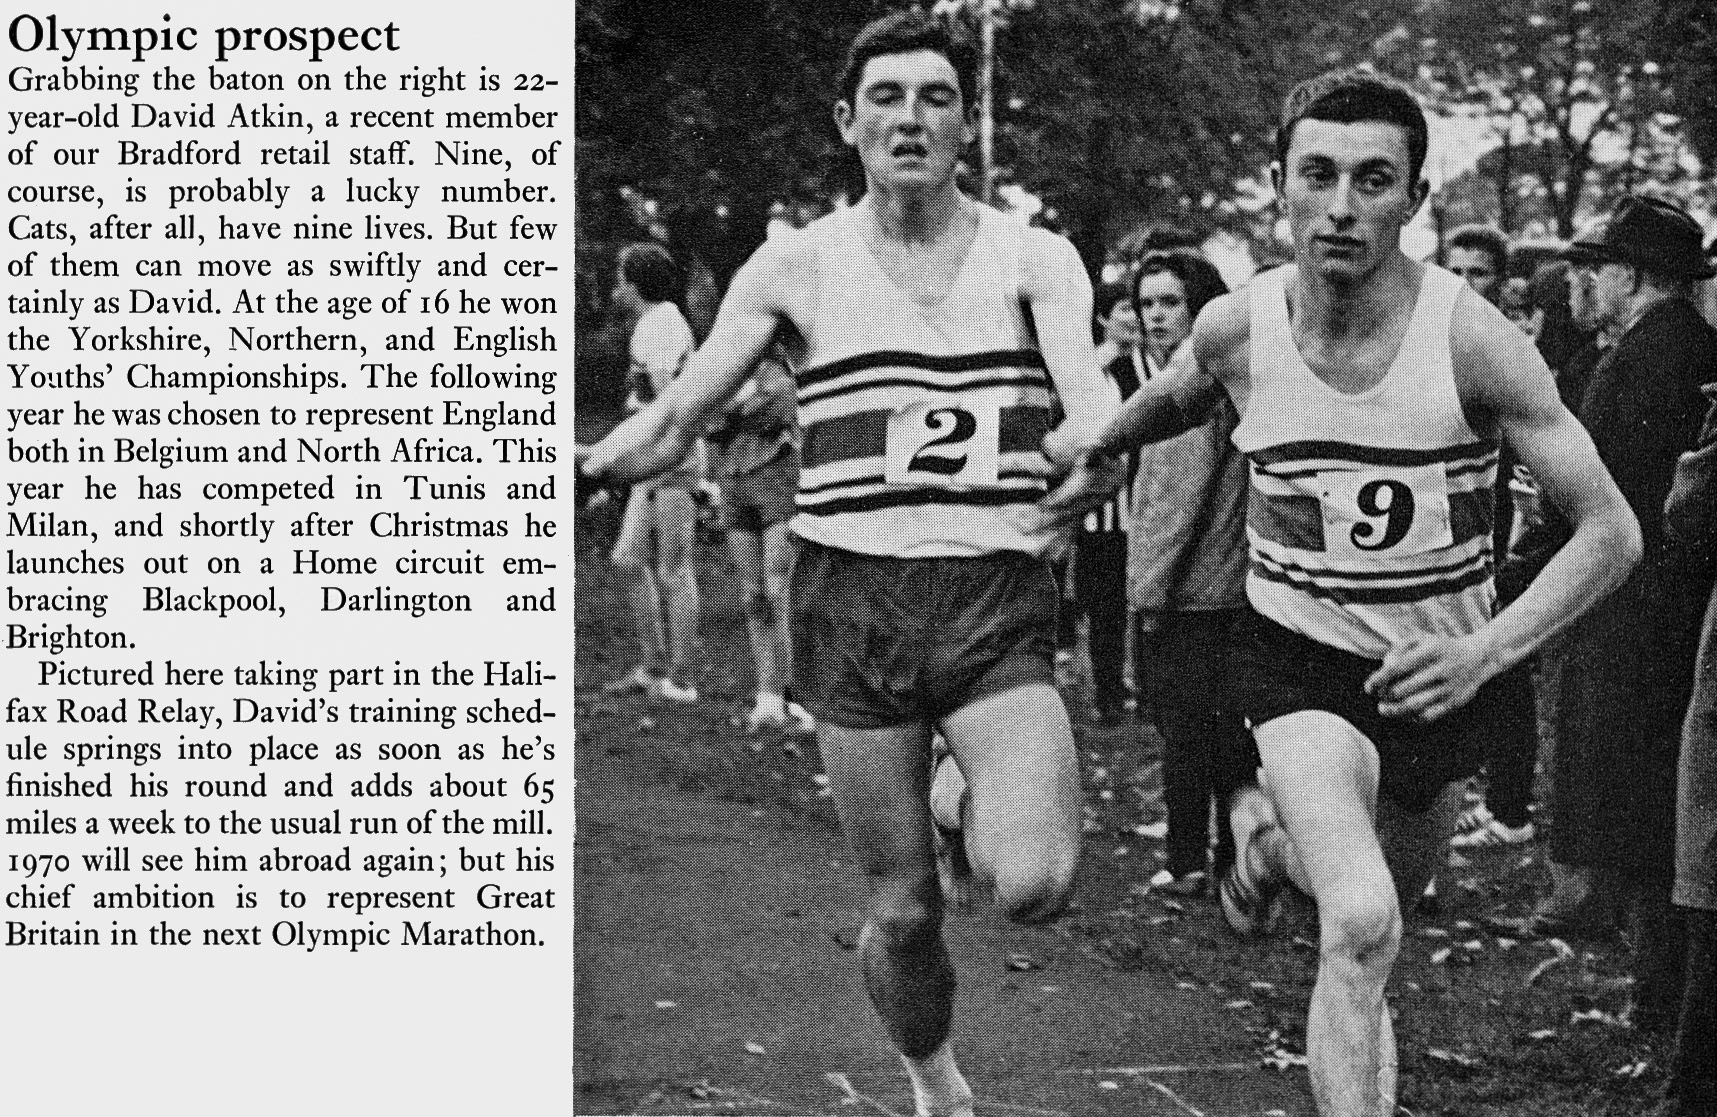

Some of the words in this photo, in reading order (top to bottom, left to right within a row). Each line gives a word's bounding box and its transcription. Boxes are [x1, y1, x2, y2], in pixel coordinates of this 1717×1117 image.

[8, 13, 198, 63] Olympic
[214, 21, 401, 63] prospect
[8, 64, 141, 98] Grabbing
[152, 65, 196, 91] the
[207, 64, 285, 91] baton
[297, 73, 332, 91] on
[343, 64, 387, 91] the
[399, 65, 467, 98] right
[478, 65, 501, 92] is
[513, 73, 559, 92] 22-
[7, 102, 120, 135] year-old
[130, 102, 216, 129] David
[226, 102, 314, 135] Atkin,
[325, 110, 340, 128] a
[349, 108, 435, 128] recent
[445, 102, 559, 129] member
[7, 139, 39, 166] of
[53, 148, 100, 166] our
[117, 139, 242, 166] Bradford
[260, 139, 331, 166] retail
[349, 139, 415, 166] staff.
[434, 140, 512, 173] Nine,
[531, 139, 562, 166] of
[7, 184, 104, 210] course,
[125, 176, 147, 203] is
[168, 176, 291, 210] probably
[311, 184, 326, 203] a
[345, 176, 421, 210] lucky
[440, 177, 556, 204] number.
[8, 214, 77, 247] Cats,
[89, 213, 153, 240] after
[164, 214, 205, 247] all,
[218, 214, 281, 240] have
[293, 213, 353, 240] nine
[364, 214, 433, 241] lives.
[446, 214, 498, 241] But
[509, 214, 558, 241] few
[7, 250, 39, 277] of
[49, 251, 120, 277] them
[135, 259, 183, 278] can
[197, 259, 272, 277] move
[287, 259, 314, 277] as
[329, 250, 422, 284] swiftly
[437, 251, 488, 277] and
[503, 259, 559, 278] cer-
[7, 288, 85, 321] tainly
[93, 296, 120, 314] as
[128, 287, 222, 315] David.
[231, 288, 267, 314] At
[275, 287, 319, 314] the
[327, 296, 373, 321] age
[381, 288, 412, 314] of
[420, 288, 450, 315] 16
[458, 288, 491, 314] he
[500, 297, 558, 315] won
[7, 325, 50, 352] the
[67, 325, 211, 358] Yorkshire,
[228, 325, 367, 358] Northern,
[385, 325, 436, 352] and
[453, 325, 558, 358] English
[126, 362, 347, 396] Championships.
[359, 362, 418, 389] The
[429, 362, 558, 396] following
[6, 408, 65, 433] year
[73, 399, 105, 426] he
[111, 408, 161, 426] was
[167, 399, 261, 426] chosen
[269, 405, 297, 426] to
[305, 405, 434, 433] represent
[442, 400, 557, 433] England
[6, 436, 70, 464] both
[78, 437, 105, 463] in
[113, 436, 229, 470] Belgium
[237, 437, 288, 464] and
[296, 436, 382, 464] North
[390, 437, 483, 464] Africa.
[492, 437, 557, 464] This
[907, 407, 977, 475] 2
[6, 482, 64, 507] year
[84, 474, 117, 500] he
[137, 474, 182, 500] has
[202, 473, 335, 507] competed
[355, 474, 383, 500] in
[402, 474, 486, 501] Tunis
[506, 474, 557, 501] and
[5, 511, 98, 544] Milan,
[114, 511, 164, 538] and
[179, 511, 276, 544] shortly
[290, 511, 354, 537] after
[369, 511, 509, 538] Christmas
[524, 511, 557, 538] he
[1350, 479, 1415, 551] 9
[6, 548, 125, 575] launches
[143, 553, 189, 575] out
[207, 556, 242, 575] on
[259, 556, 275, 575] a
[292, 549, 378, 575] Home
[395, 548, 485, 575] circuit
[502, 557, 557, 575] em-
[6, 585, 109, 619] bracing
[142, 585, 286, 619] Blackpool,
[320, 585, 473, 619] Darlington
[506, 586, 557, 612] and
[5, 622, 136, 656] Brighton.
[37, 659, 155, 687] Pictured
[164, 659, 224, 686] here
[233, 659, 319, 693] taking
[328, 665, 385, 693] part
[393, 659, 421, 686] in
[430, 660, 474, 687] the
[483, 660, 557, 687] Hali-
[5, 697, 48, 723] fax
[56, 697, 128, 724] Road
[137, 697, 223, 730] Relay,
[348, 697, 457, 730] training
[466, 697, 557, 724] sched-
[5, 734, 48, 761] ule
[63, 734, 162, 767] springs
[177, 734, 232, 760] into
[248, 734, 319, 767] place
[335, 742, 362, 761] as
[378, 742, 442, 761] soon
[457, 742, 485, 761] as
[5, 771, 113, 798] finished
[129, 771, 169, 798] his
[184, 771, 268, 798] round
[284, 771, 334, 798] and
[350, 771, 413, 798] adds
[429, 771, 508, 798] about
[523, 771, 555, 805] 65
[5, 808, 77, 835] miles
[85, 817, 100, 835] a
[107, 808, 176, 835] week
[183, 814, 211, 835] to
[218, 809, 262, 835] the
[269, 808, 342, 835] usual
[349, 817, 399, 835] run
[406, 808, 438, 835] of
[441, 808, 485, 835] the
[492, 809, 553, 835] mill.
[8, 853, 70, 879] 1970
[81, 845, 131, 872] will
[141, 854, 184, 872] see
[194, 845, 248, 872] him
[259, 845, 352, 872] abroad
[363, 846, 447, 879] again;
[458, 846, 506, 873] but
[515, 846, 555, 872] his
[5, 883, 76, 909] chief
[93, 883, 216, 909] ambition
[235, 883, 258, 909] is
[279, 888, 307, 909] to
[326, 888, 456, 916] represent
[476, 883, 556, 910] Great
[4, 920, 101, 947] Britain
[110, 920, 138, 946] in
[148, 920, 192, 946] the
[202, 925, 262, 946] next
[271, 920, 391, 953] Olympic
[400, 920, 545, 947] Marathon.
